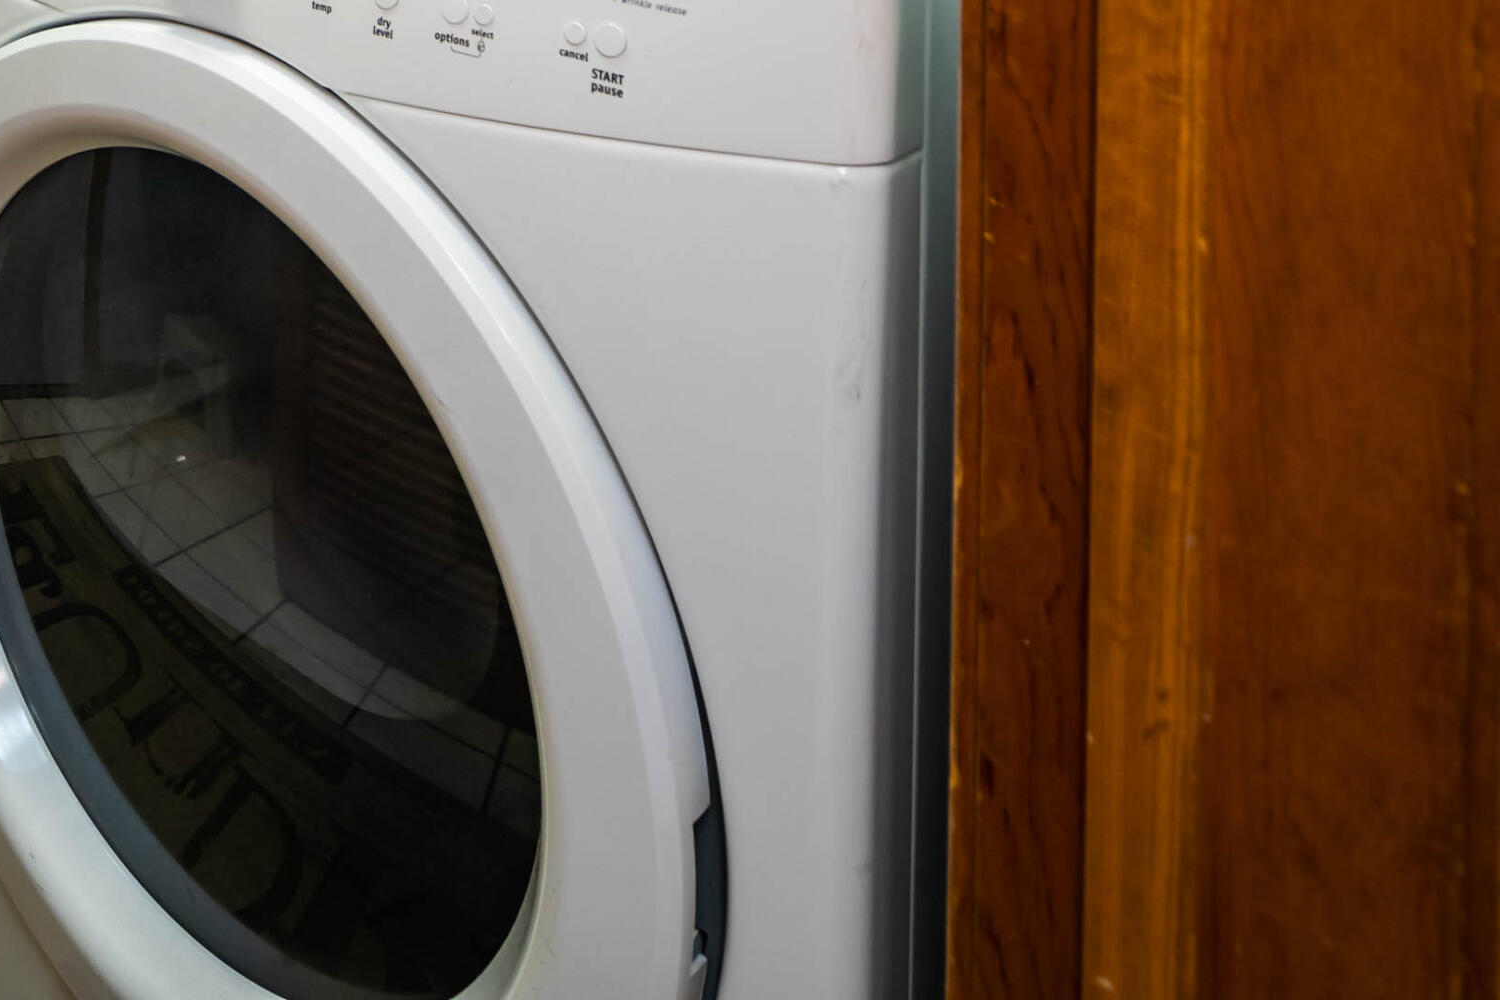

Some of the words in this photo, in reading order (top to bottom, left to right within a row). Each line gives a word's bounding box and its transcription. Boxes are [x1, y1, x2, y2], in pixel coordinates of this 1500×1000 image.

[312, 1, 332, 14] temp
[655, 3, 688, 16] release
[377, 16, 392, 30] dry
[373, 26, 394, 40] level
[434, 31, 470, 48] options
[471, 27, 494, 40] select
[559, 48, 589, 62] cancel
[591, 68, 625, 85] START
[591, 82, 624, 98] pause
